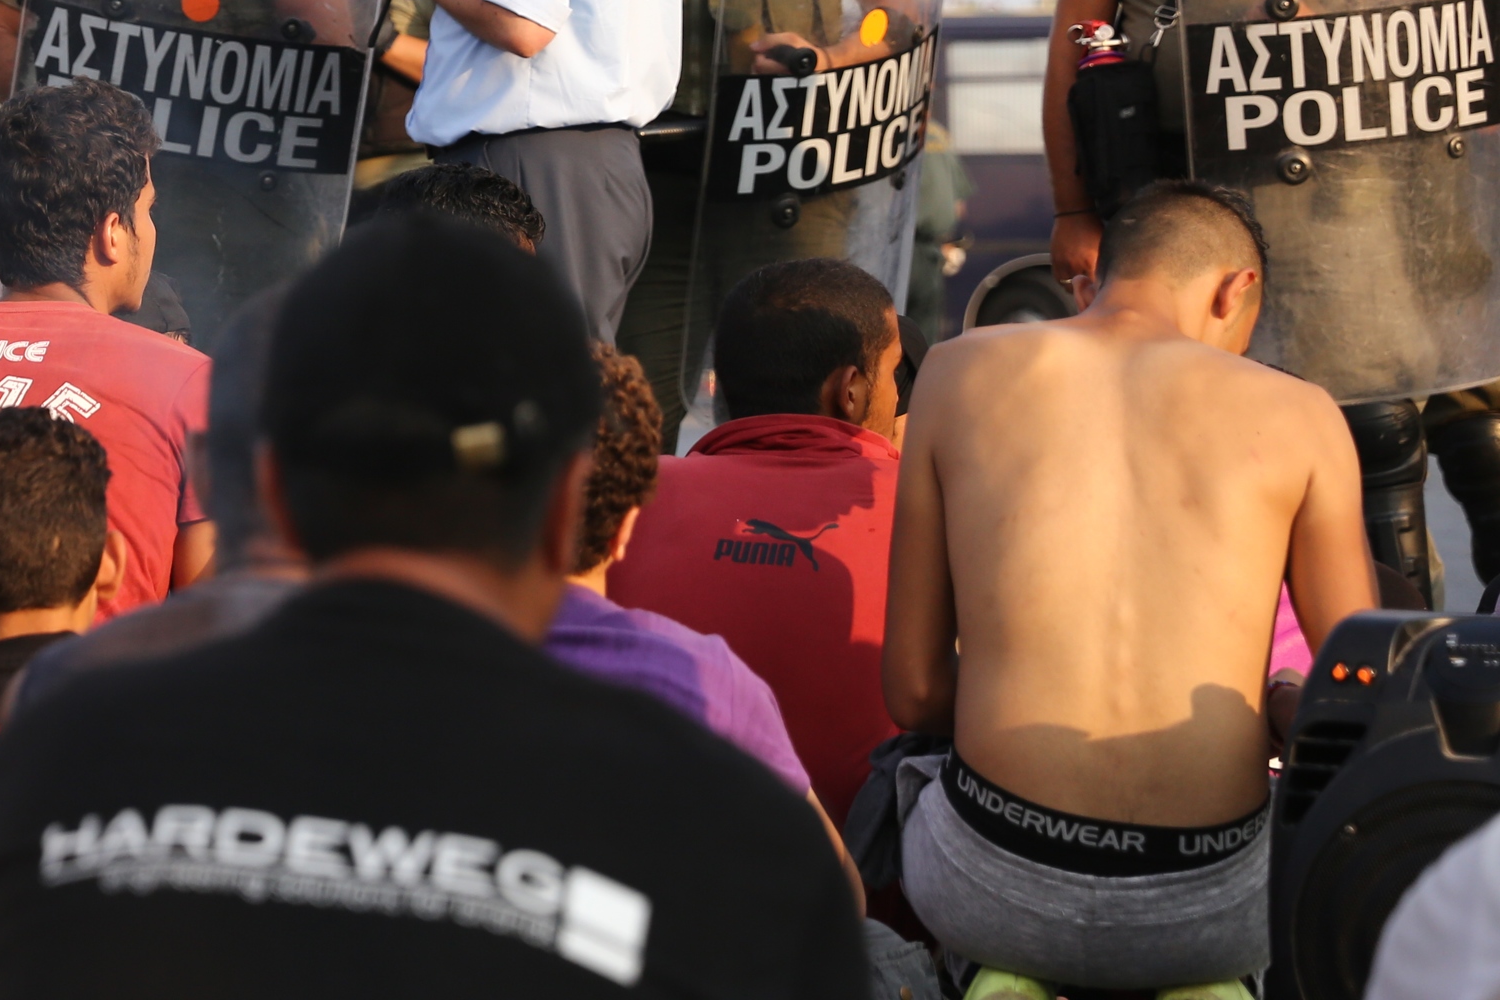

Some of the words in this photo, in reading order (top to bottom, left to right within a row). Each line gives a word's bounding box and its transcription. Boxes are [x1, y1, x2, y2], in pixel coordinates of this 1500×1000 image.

[35, 7, 341, 116] ΑΣΤΥΝΟΜΙΑ
[47, 74, 324, 169] LICE
[737, 101, 924, 194] POLICE
[1225, 68, 1487, 150] POLICE
[957, 768, 1146, 854] UNDERWEAR
[40, 804, 566, 918] HARDEWEG
